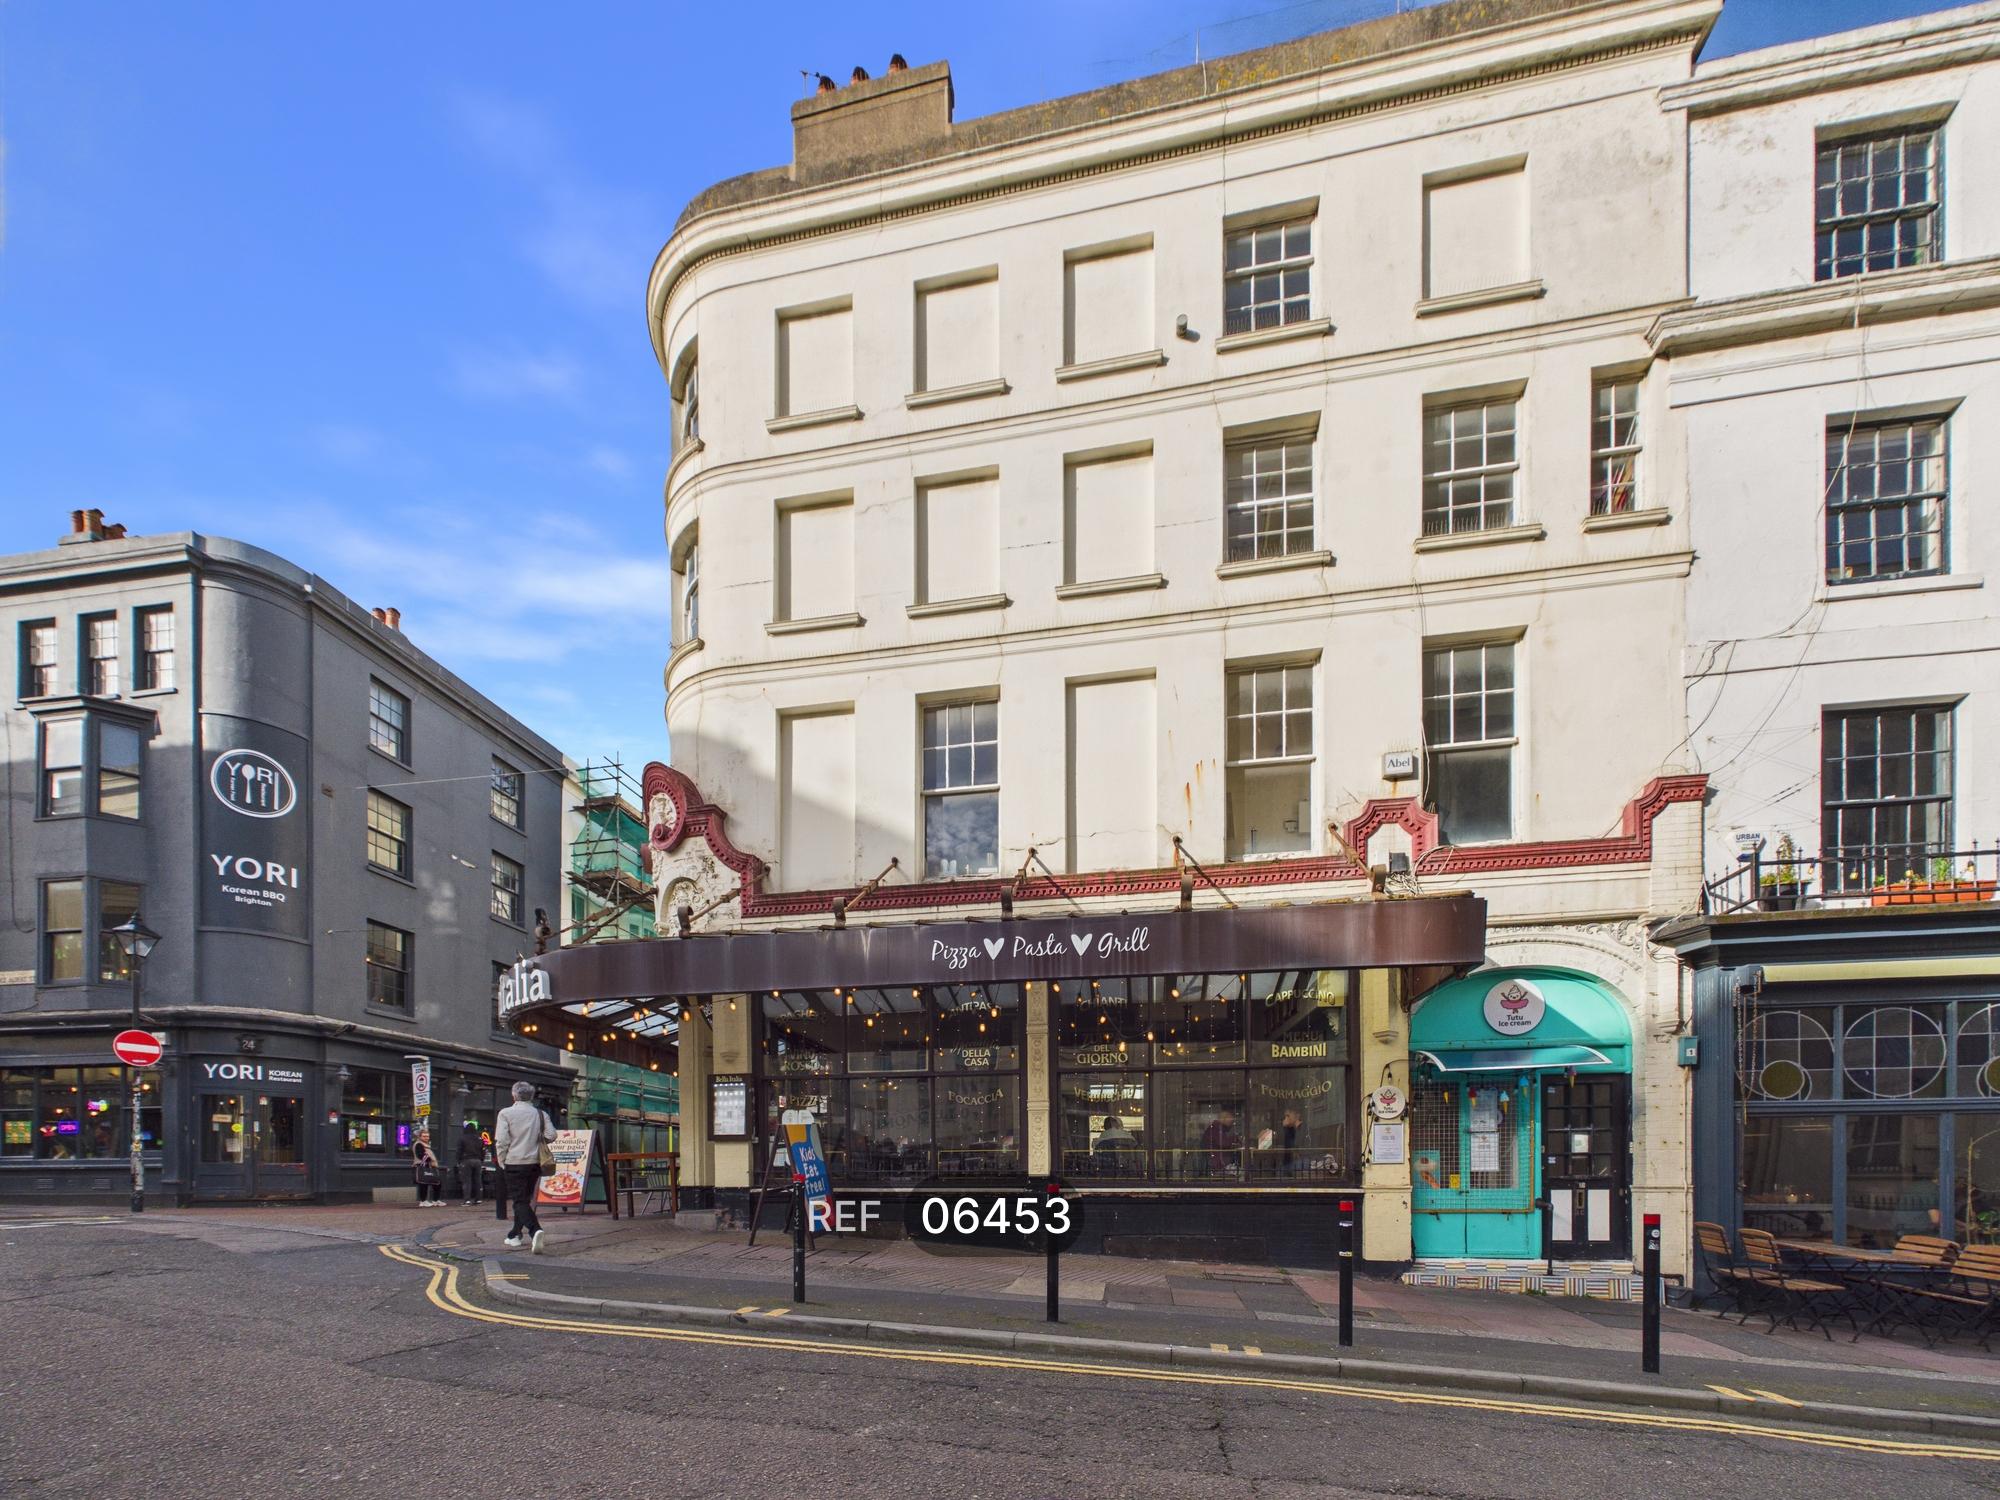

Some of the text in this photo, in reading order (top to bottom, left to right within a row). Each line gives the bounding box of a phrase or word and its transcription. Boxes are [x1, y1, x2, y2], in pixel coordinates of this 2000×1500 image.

[1387, 757, 1410, 768] Abel
[1736, 833, 1760, 841] URBAN
[211, 854, 298, 889] YORI
[222, 884, 286, 902] Korean BBQ
[235, 895, 272, 906] Brighton
[931, 926, 1150, 970] Pizza Pasta Grill
[1265, 988, 1336, 1007] CAPPUCCINO
[242, 1040, 255, 1050] 24
[1272, 1043, 1327, 1058] BAMBINI
[962, 1049, 991, 1058] DELLA
[1077, 1053, 1129, 1064] GIORNO
[964, 1058, 989, 1067] CASA
[204, 1064, 302, 1080] YORI KOREAN
[948, 1087, 1004, 1106] FOCACCIA
[1261, 1080, 1332, 1099] FORMAGGIO
[800, 1146, 815, 1162] Kids
[803, 1162, 819, 1178] Eat
[805, 1179, 825, 1195] Free!
